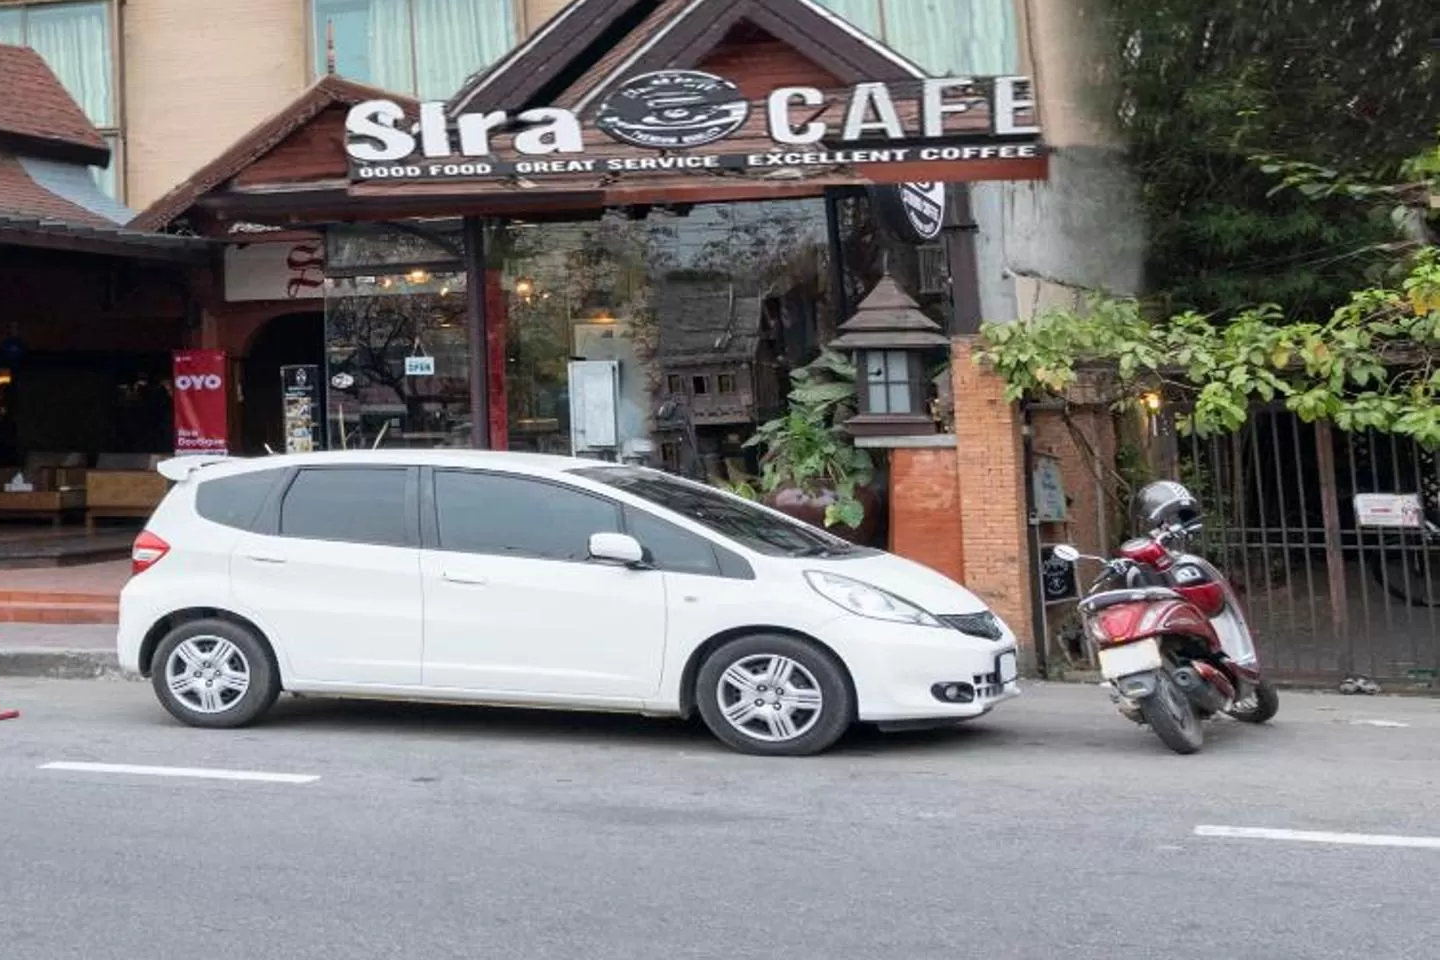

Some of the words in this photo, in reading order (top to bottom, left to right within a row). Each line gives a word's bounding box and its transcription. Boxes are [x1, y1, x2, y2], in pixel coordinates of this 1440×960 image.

[768, 75, 1040, 144] CAFE
[360, 166, 420, 178] GOOD
[429, 163, 492, 176] FOOD
[516, 159, 596, 173] GREAT
[607, 155, 720, 170] SERVICE
[747, 149, 910, 166] EXCELLENT
[920, 145, 1036, 161] COFFEE
[174, 374, 222, 390] OYO
